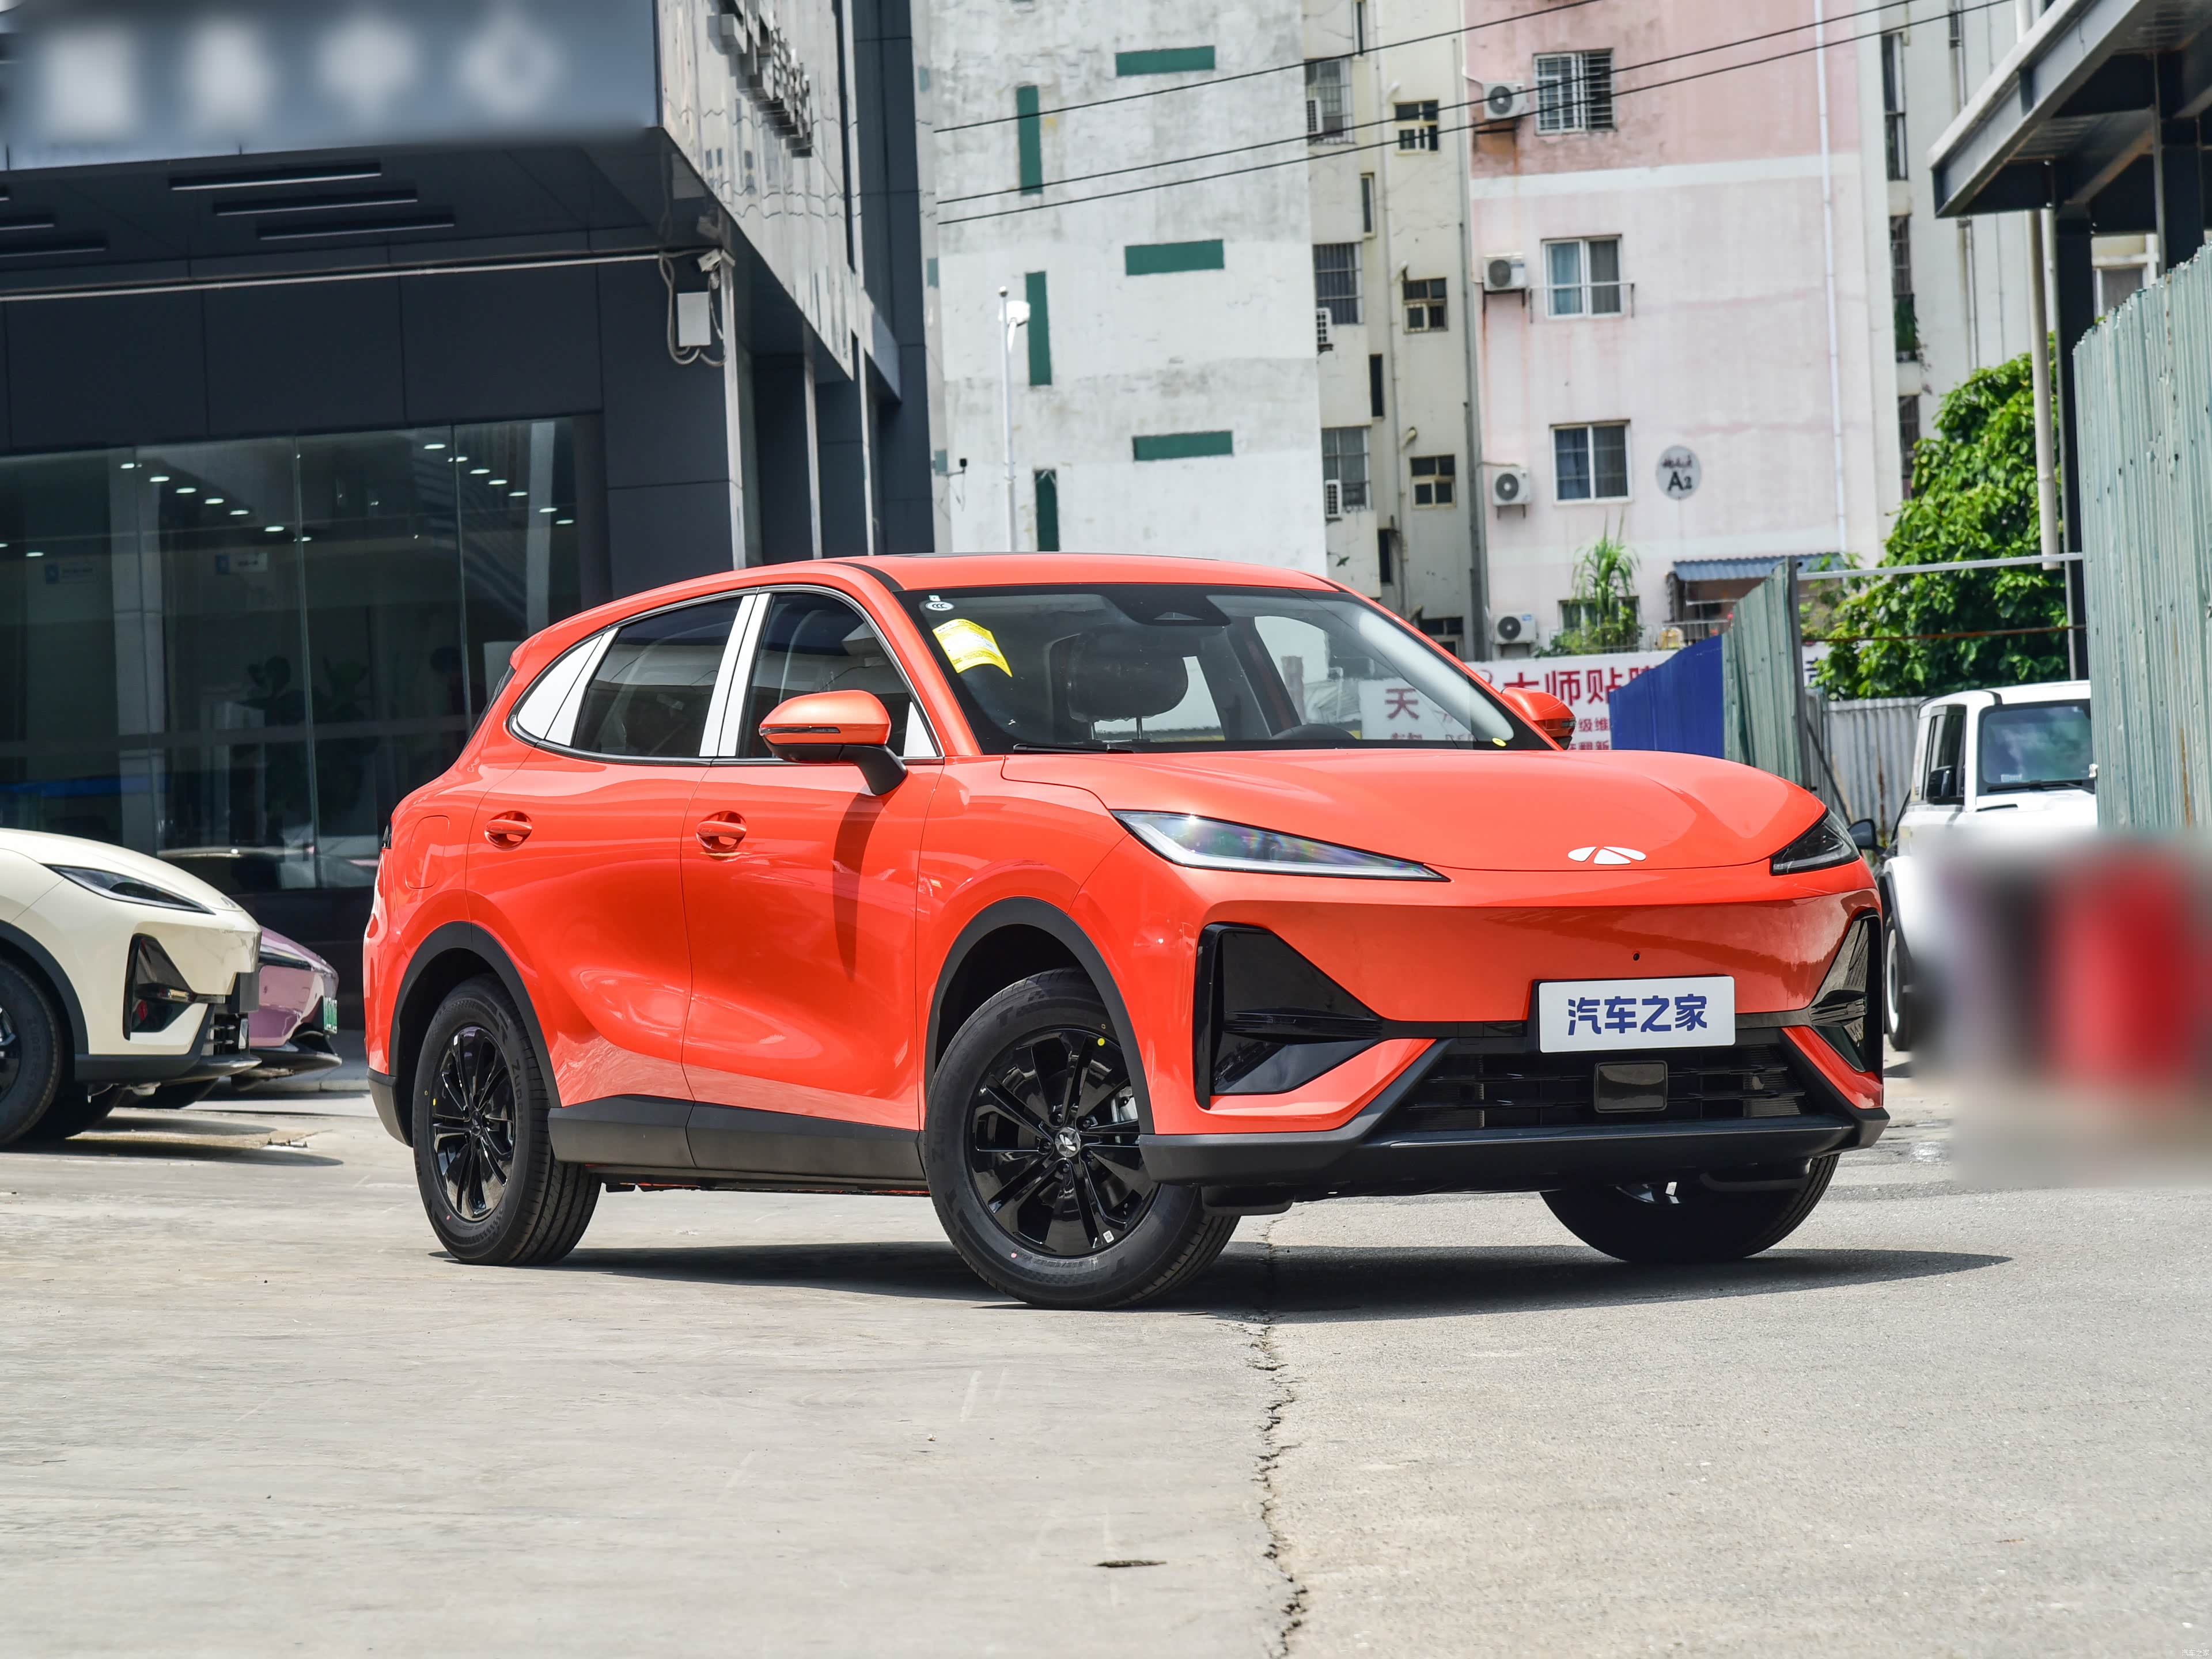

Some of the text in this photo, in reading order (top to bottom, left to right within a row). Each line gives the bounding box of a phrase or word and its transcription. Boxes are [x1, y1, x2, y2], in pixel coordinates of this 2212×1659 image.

[1667, 471, 1692, 491] A2
[1385, 688, 1419, 720] 天
[1568, 994, 1707, 1035] 汽车之家
